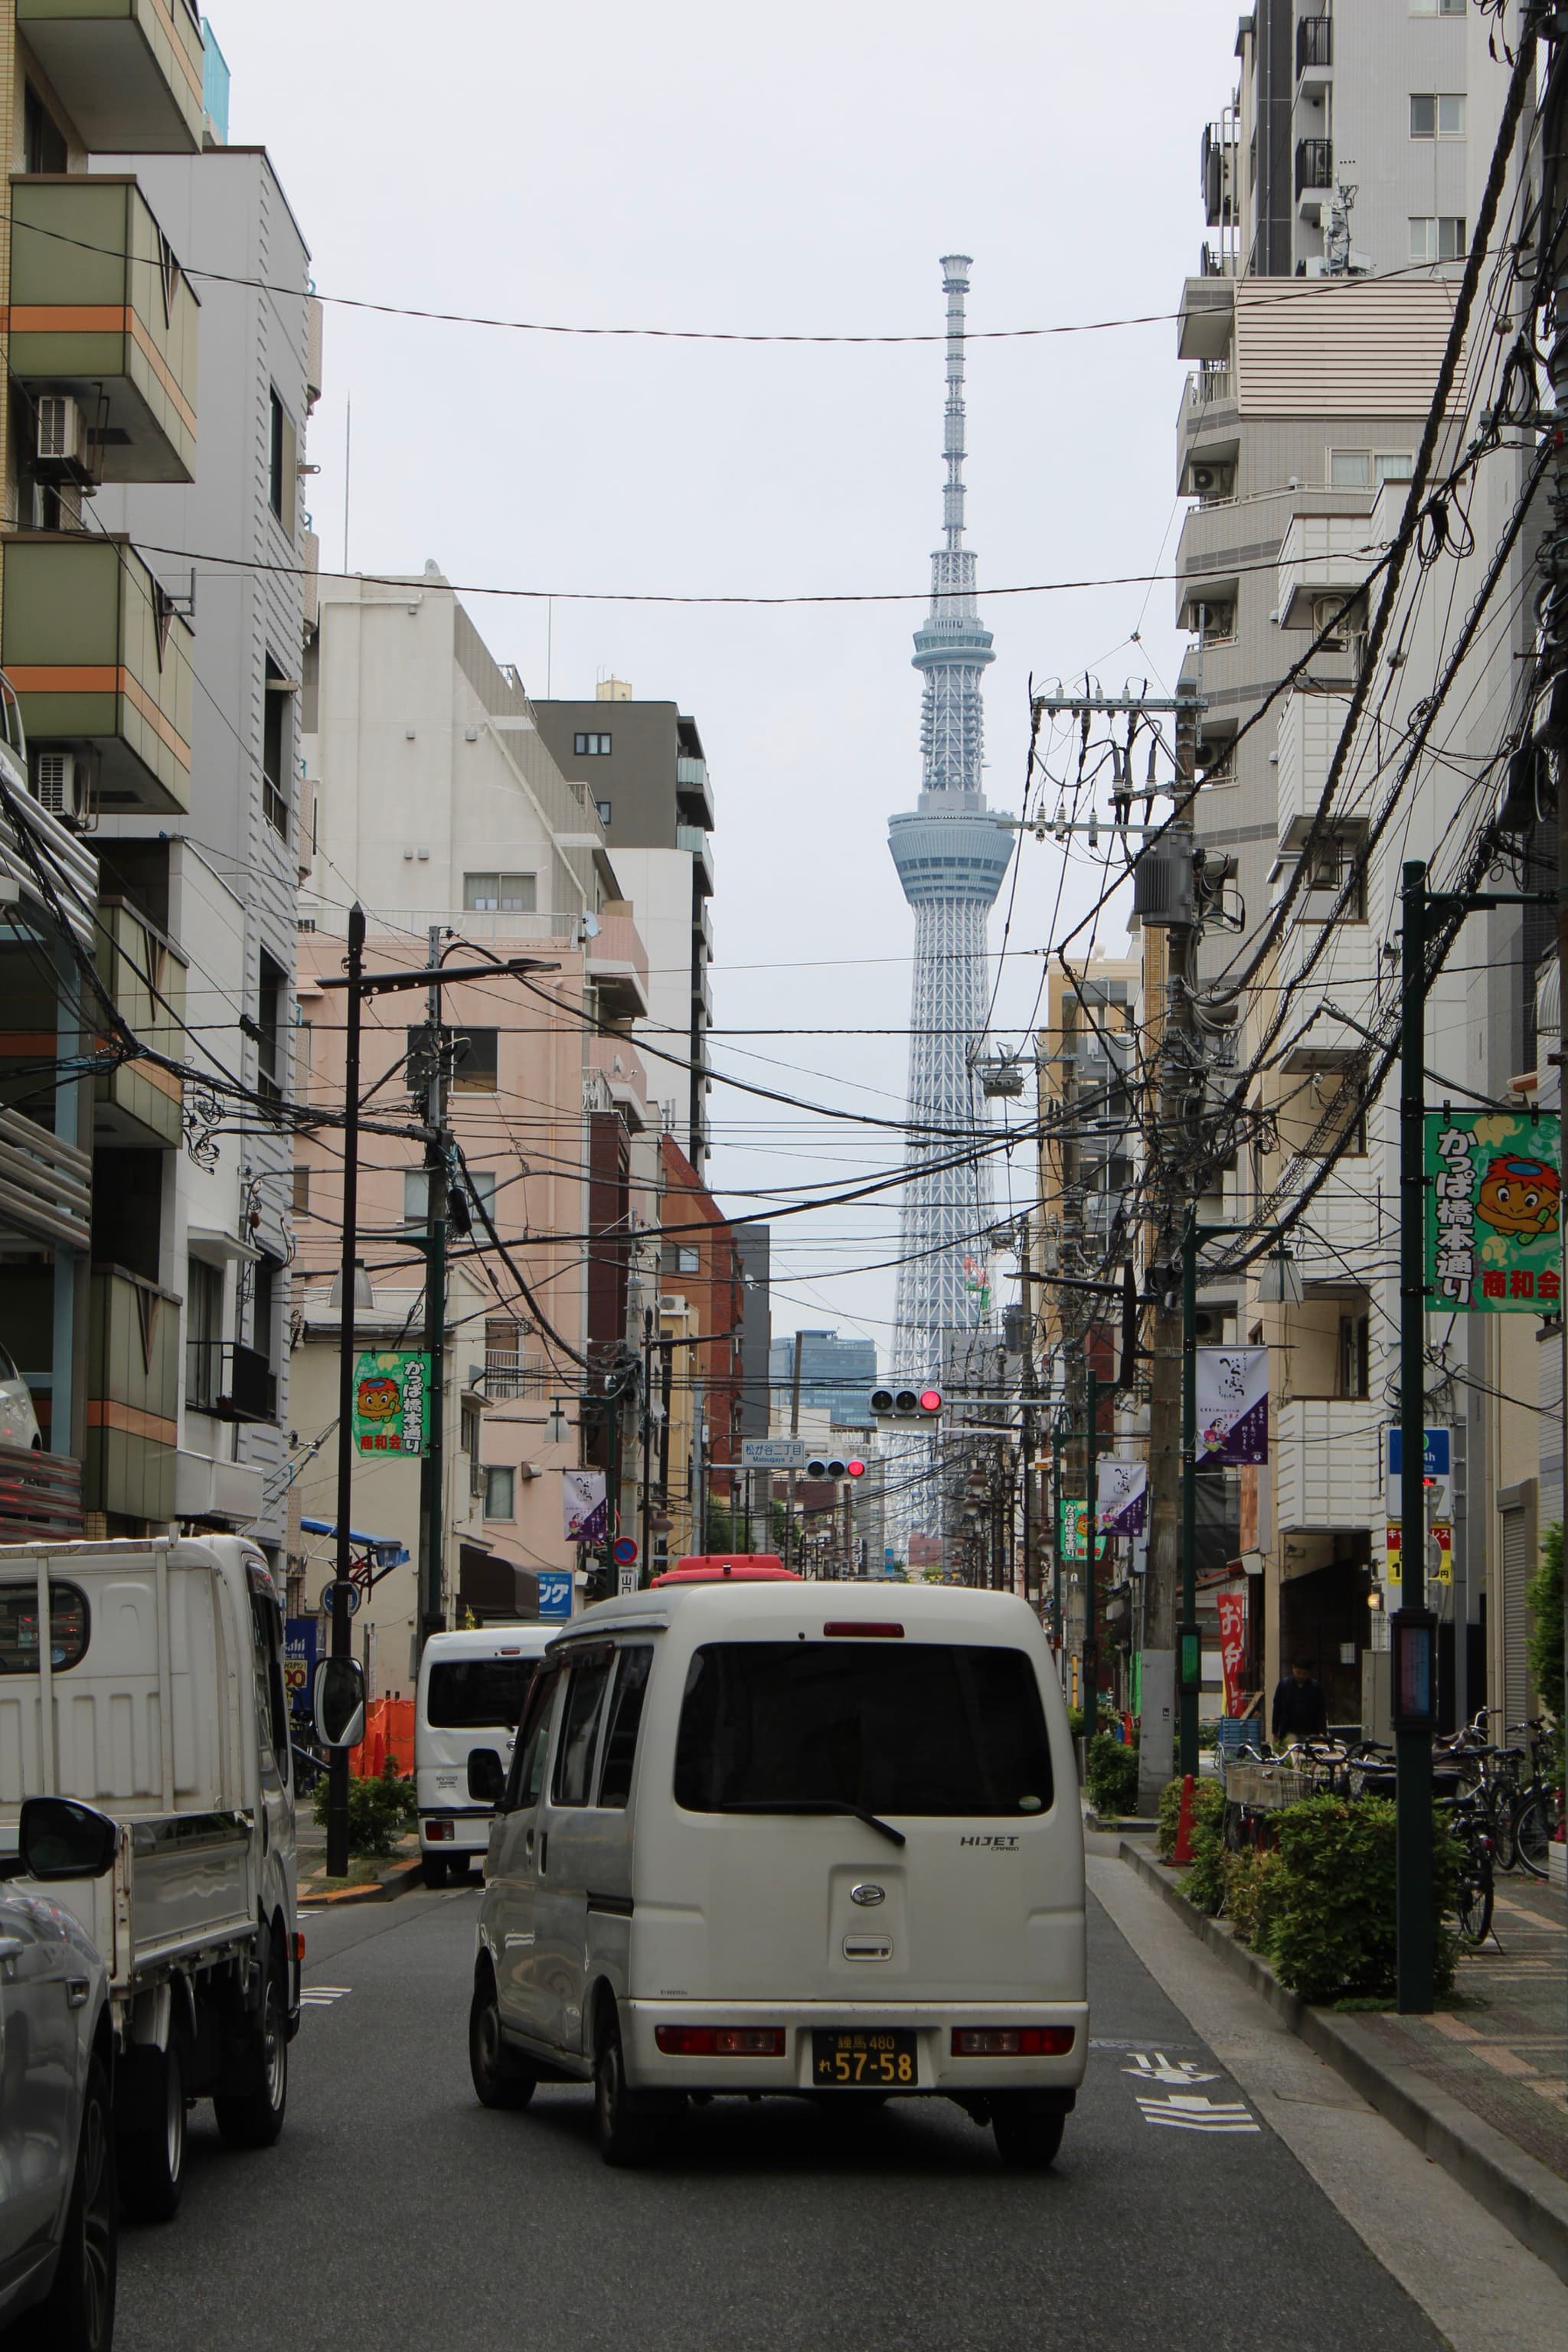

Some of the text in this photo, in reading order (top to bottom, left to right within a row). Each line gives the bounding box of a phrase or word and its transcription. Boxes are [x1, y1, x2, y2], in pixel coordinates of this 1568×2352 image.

[1434, 1124, 1478, 1305] かっぱ橋本通り
[1482, 1269, 1561, 1299] 商和会
[1220, 1358, 1245, 1396] べらぼう
[403, 1360, 425, 1454] かっぱ橋本通り
[361, 1435, 401, 1450] 商和会
[746, 1445, 802, 1455] 松が谷二丁目
[960, 1837, 1019, 1846] HIJET
[870, 2036, 894, 2050] 480
[818, 2053, 912, 2081] れ 57-58
